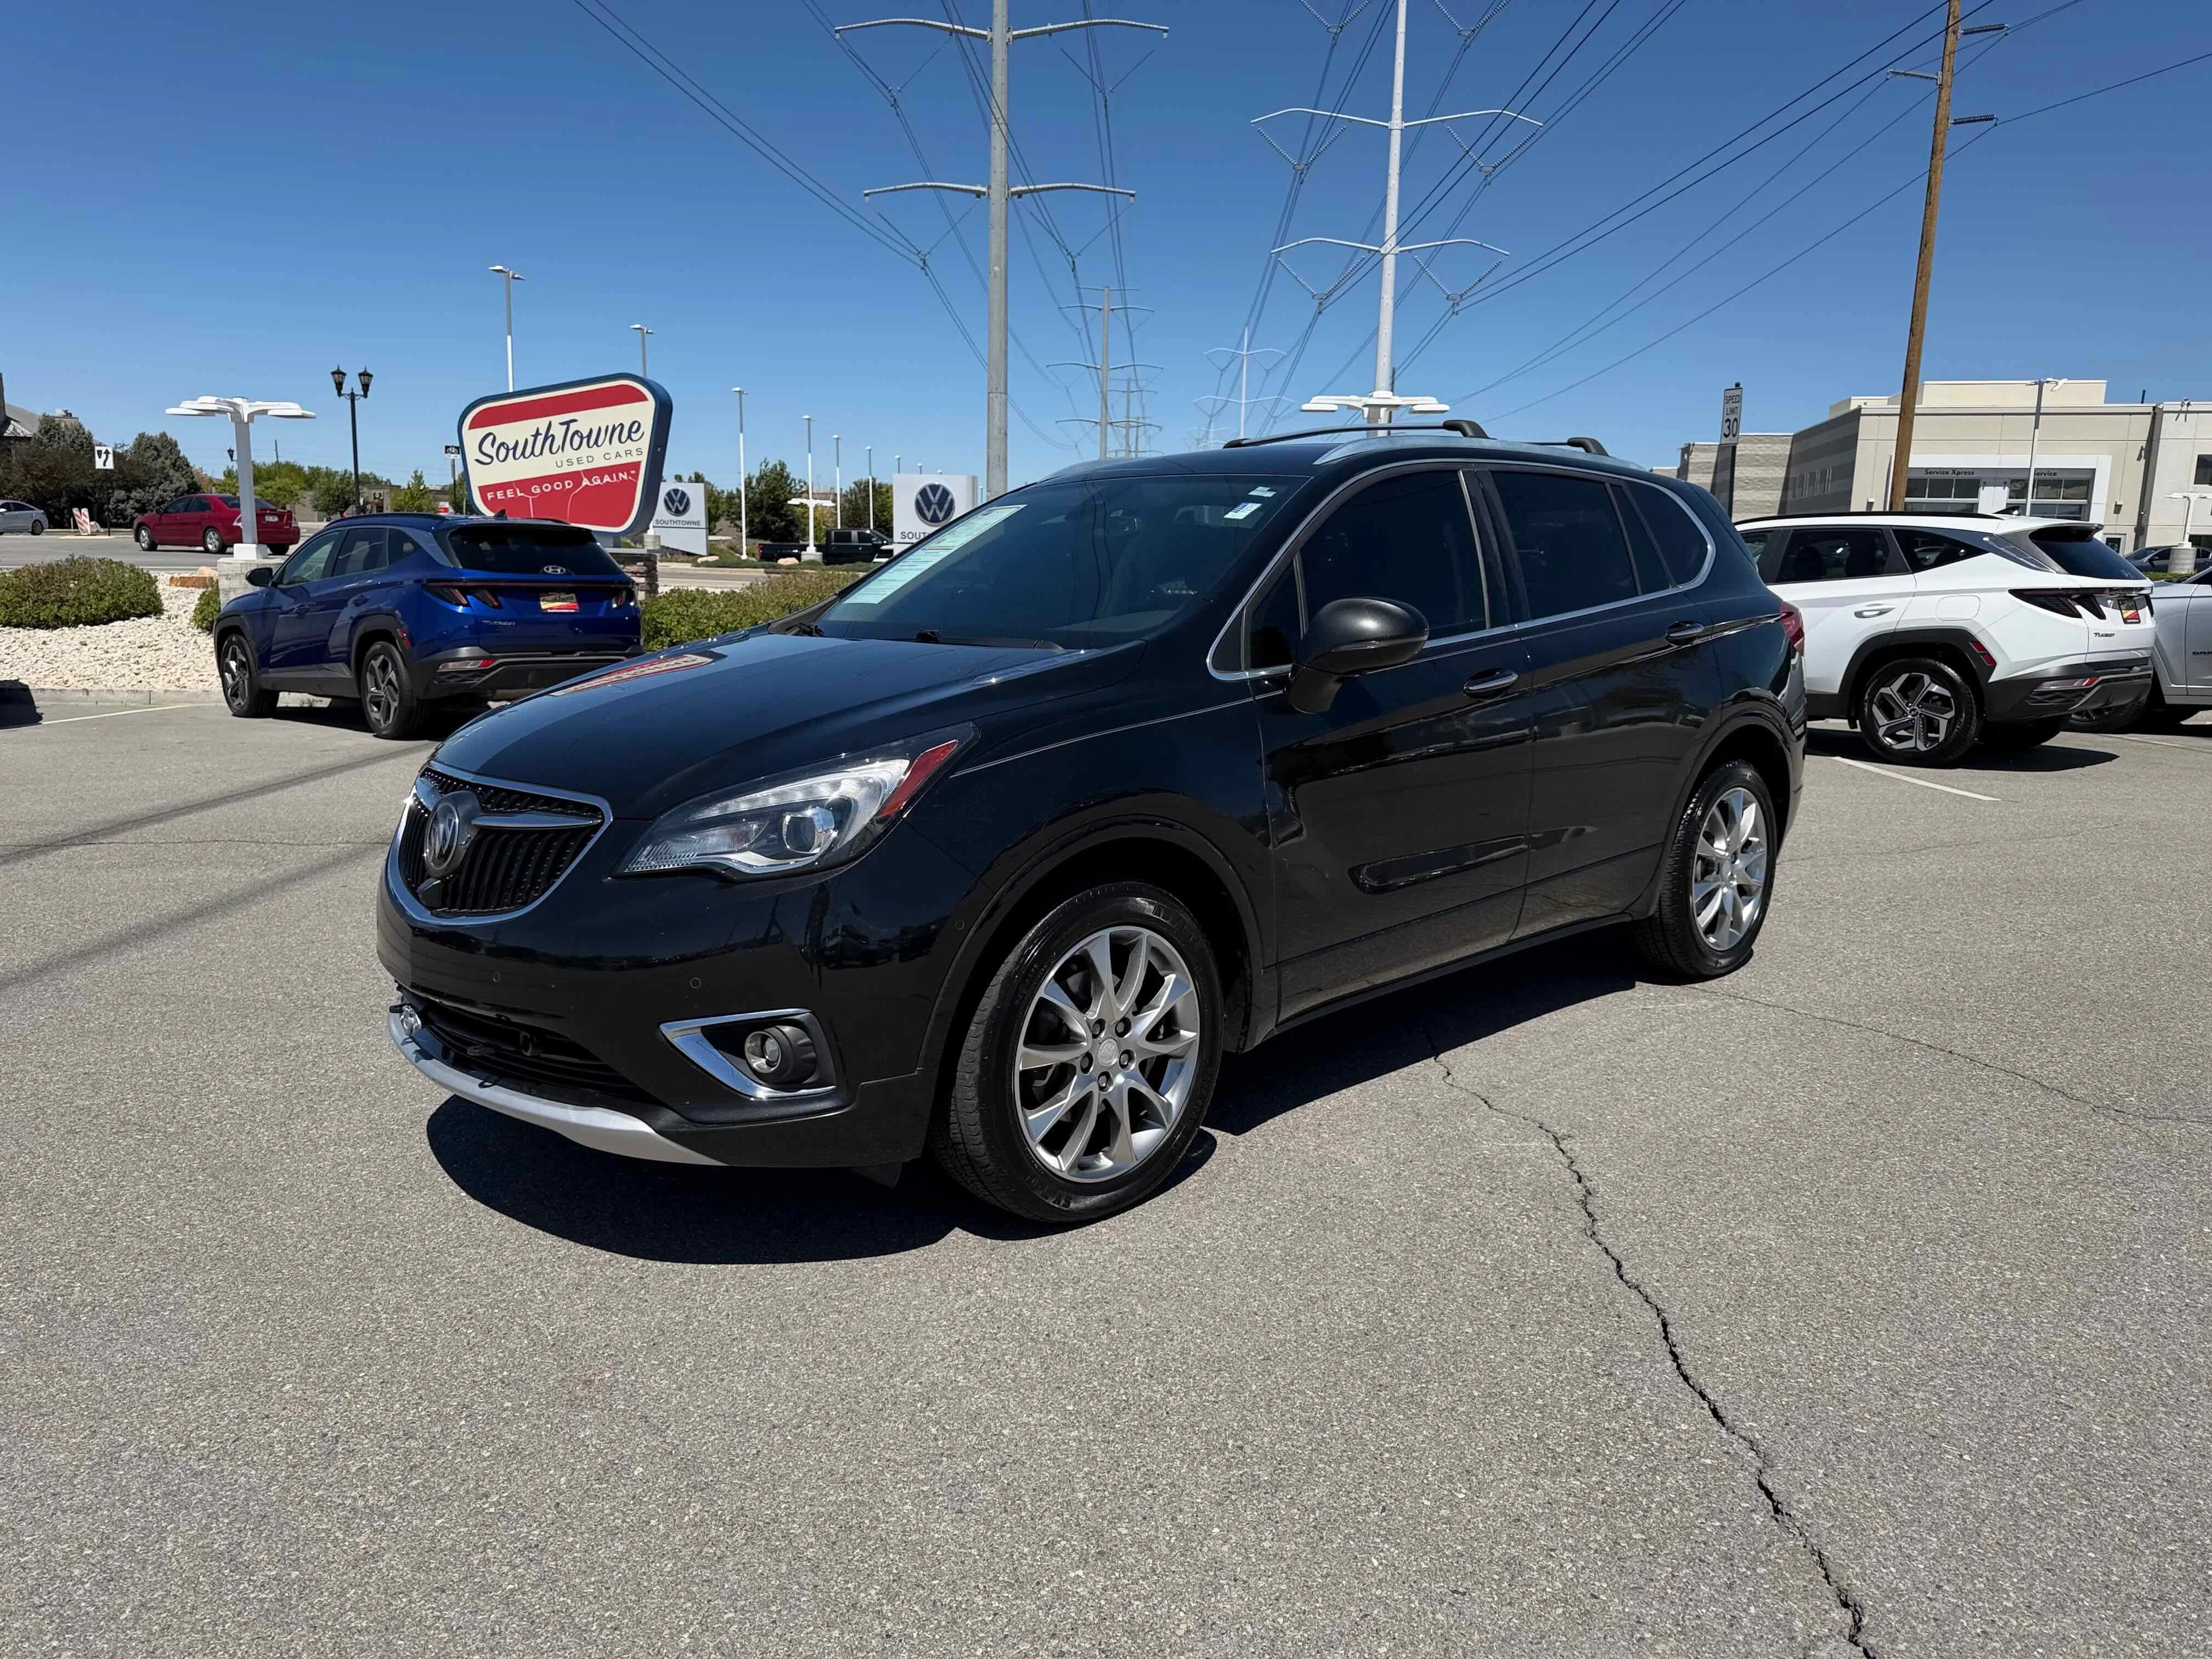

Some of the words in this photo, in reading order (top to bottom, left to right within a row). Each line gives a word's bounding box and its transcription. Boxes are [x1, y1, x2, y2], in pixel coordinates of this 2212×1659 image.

[1725, 394, 1741, 404] SPEED
[1726, 407, 1739, 415] LIMIT
[1723, 417, 1738, 438] 30
[474, 419, 645, 466] SouthTowne
[555, 455, 595, 468] USED
[603, 447, 644, 461] CARS
[487, 488, 524, 501] FEEL
[531, 479, 573, 494] GOOD
